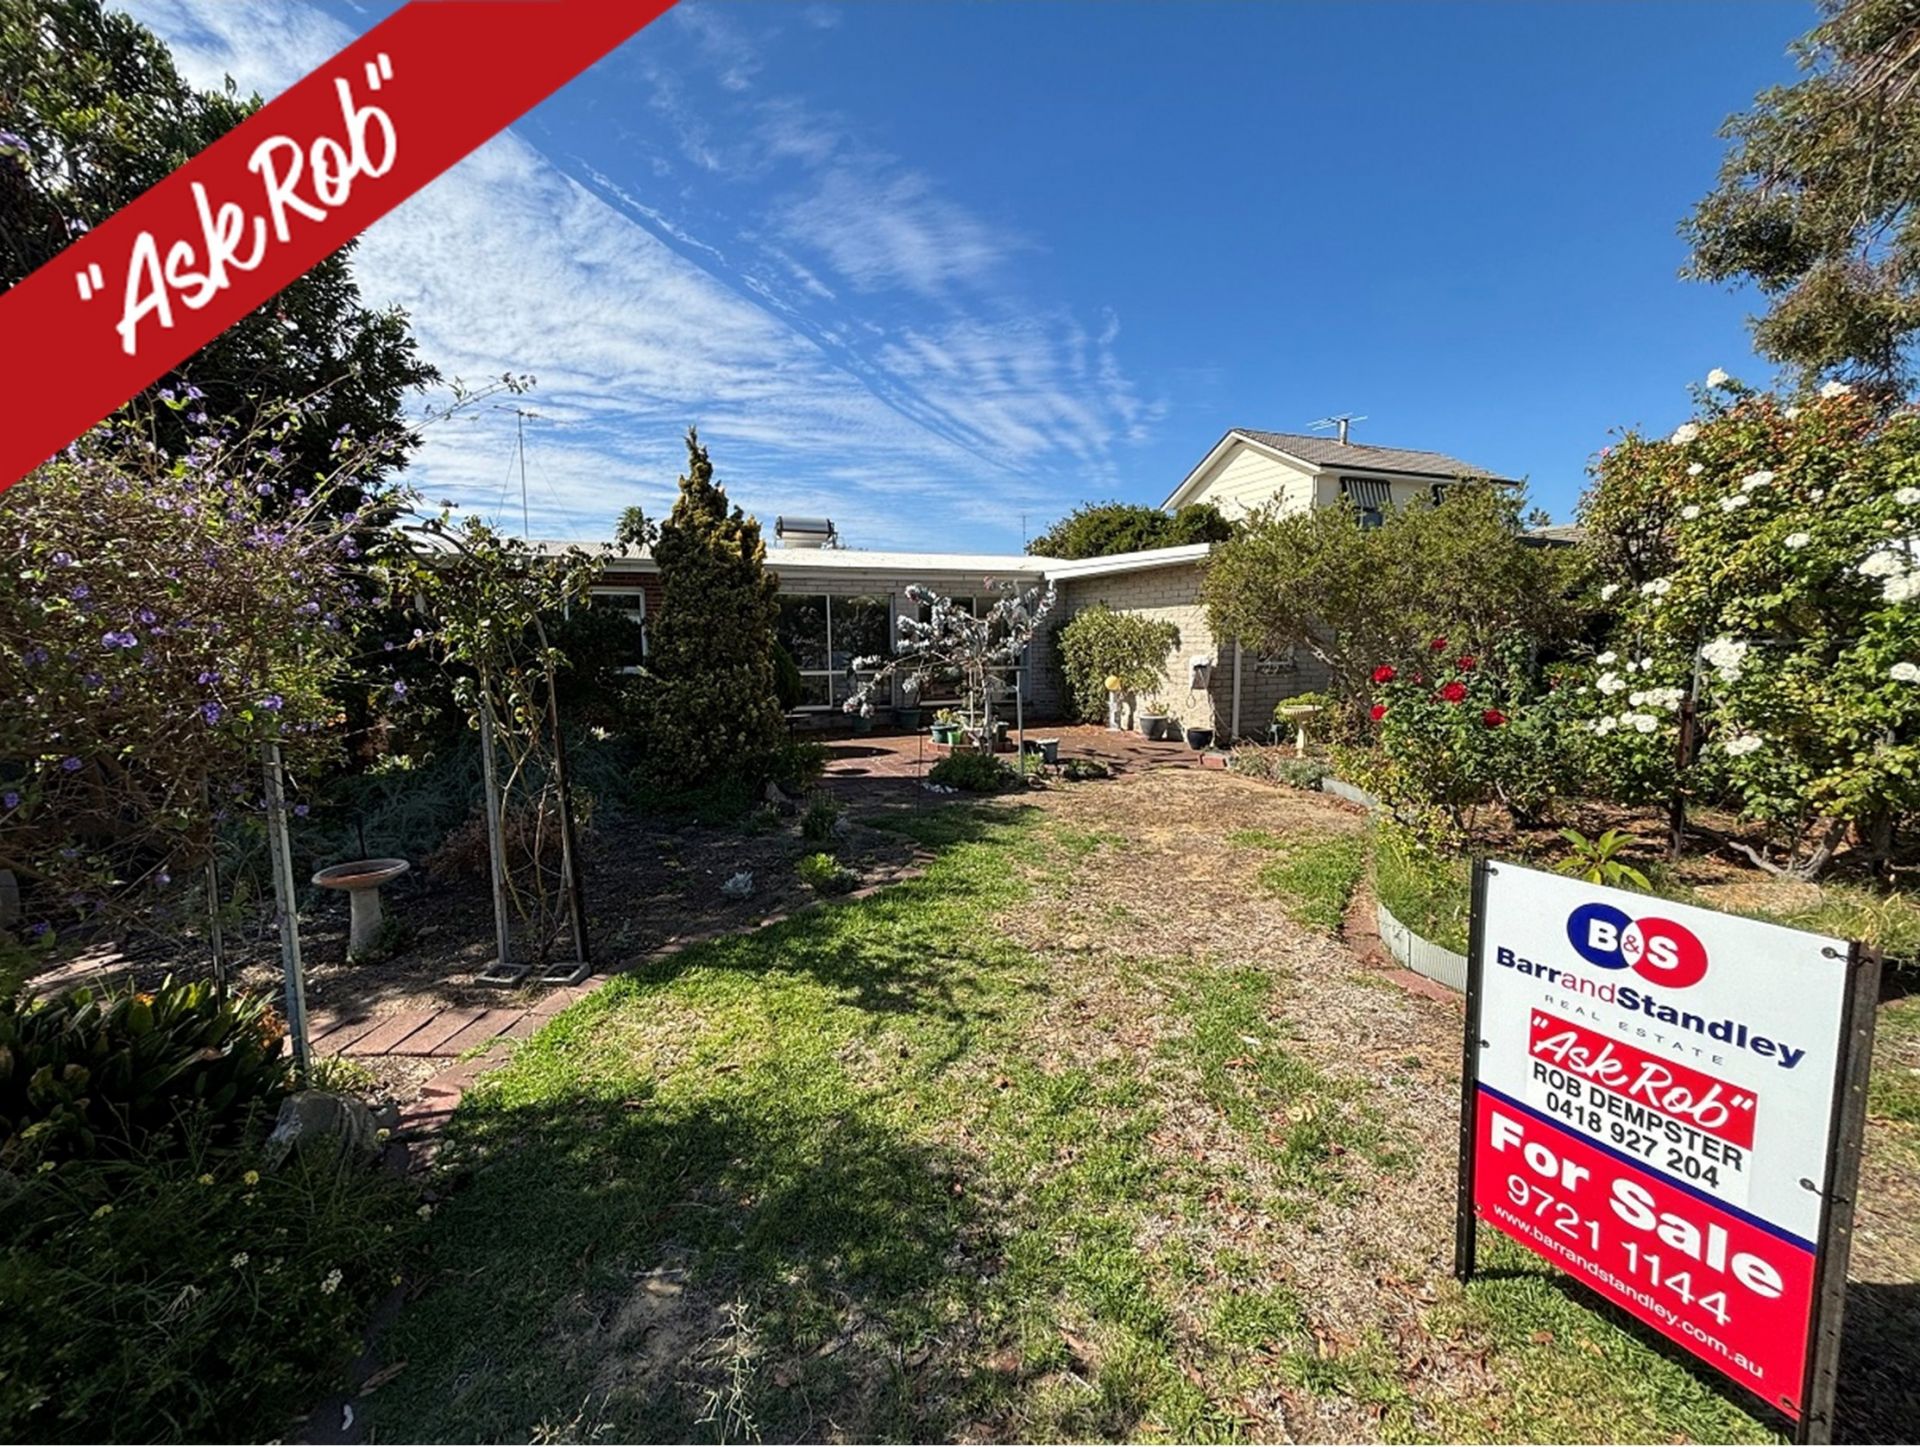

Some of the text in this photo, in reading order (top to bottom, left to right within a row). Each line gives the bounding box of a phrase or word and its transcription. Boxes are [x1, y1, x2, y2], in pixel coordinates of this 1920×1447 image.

[1588, 918, 1679, 969] B&S
[1531, 1016, 1754, 1128] "Ask Rob"
[1544, 994, 1724, 1066] REAL ESTATE
[1533, 1062, 1744, 1172] ROB DEMPSTER
[1546, 1091, 1720, 1190] 0418 927 204
[1490, 1110, 1784, 1299] For Sale
[1507, 1174, 1732, 1327] 9721 1144
[1492, 1202, 1765, 1379] www.barrandstandley.com.au
